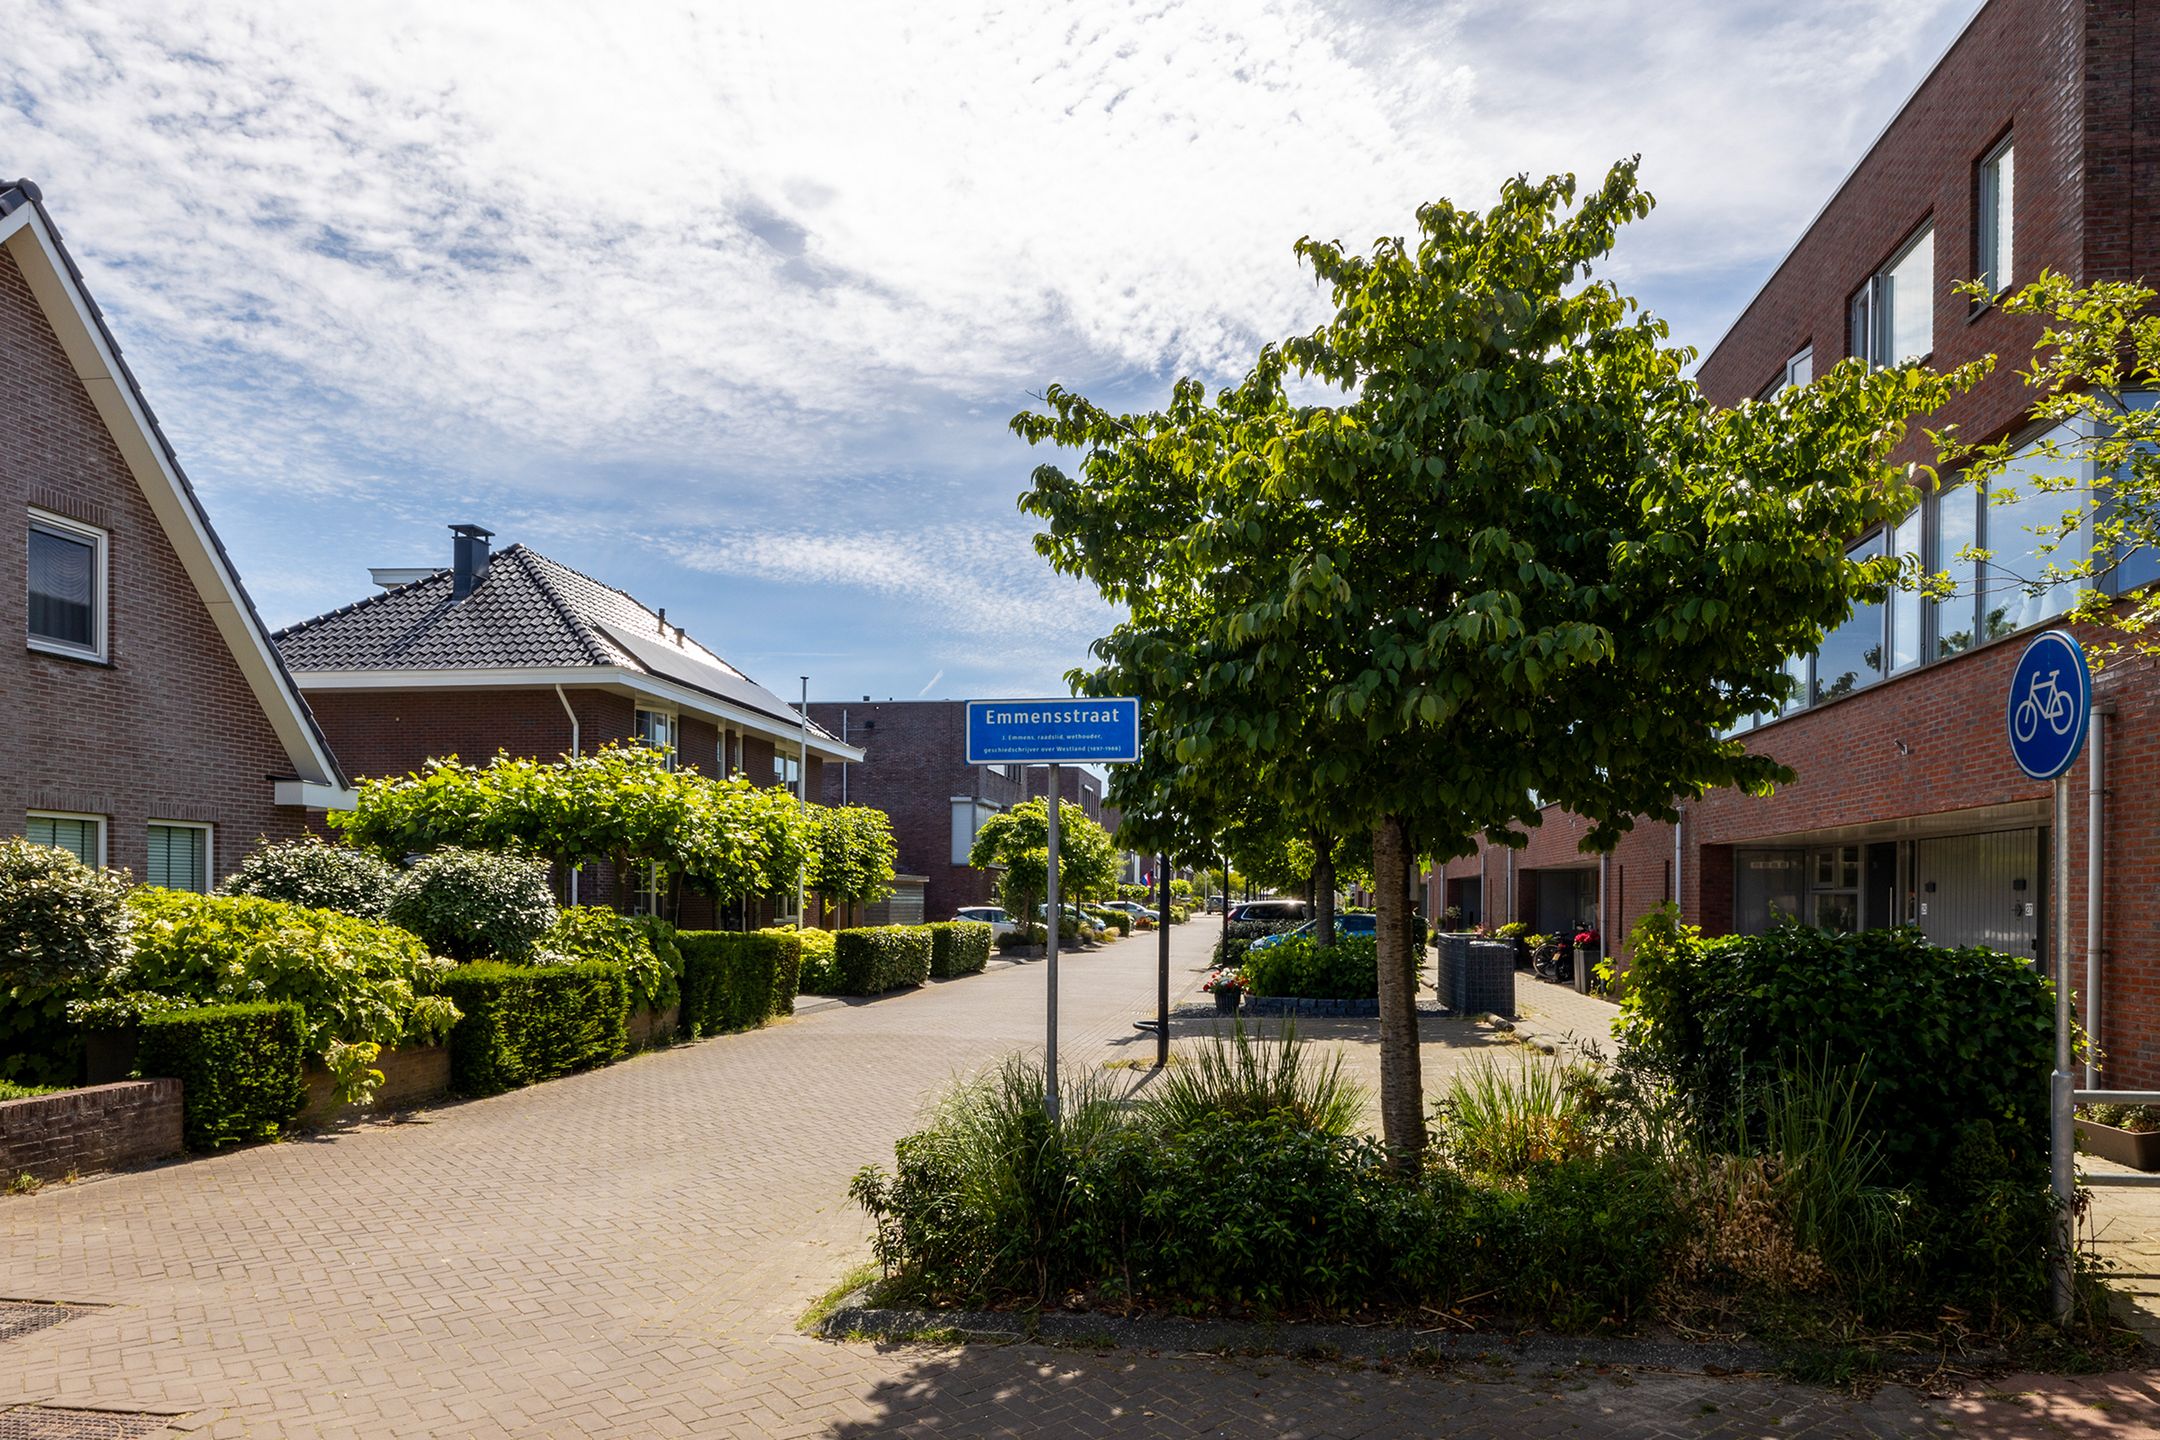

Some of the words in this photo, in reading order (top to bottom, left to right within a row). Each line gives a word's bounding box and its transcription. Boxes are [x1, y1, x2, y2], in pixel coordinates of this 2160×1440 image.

[986, 708, 1120, 725] Emmensstraat
[1037, 733, 1065, 741] raadslid,
[983, 746, 1039, 754] geschiedschrijver
